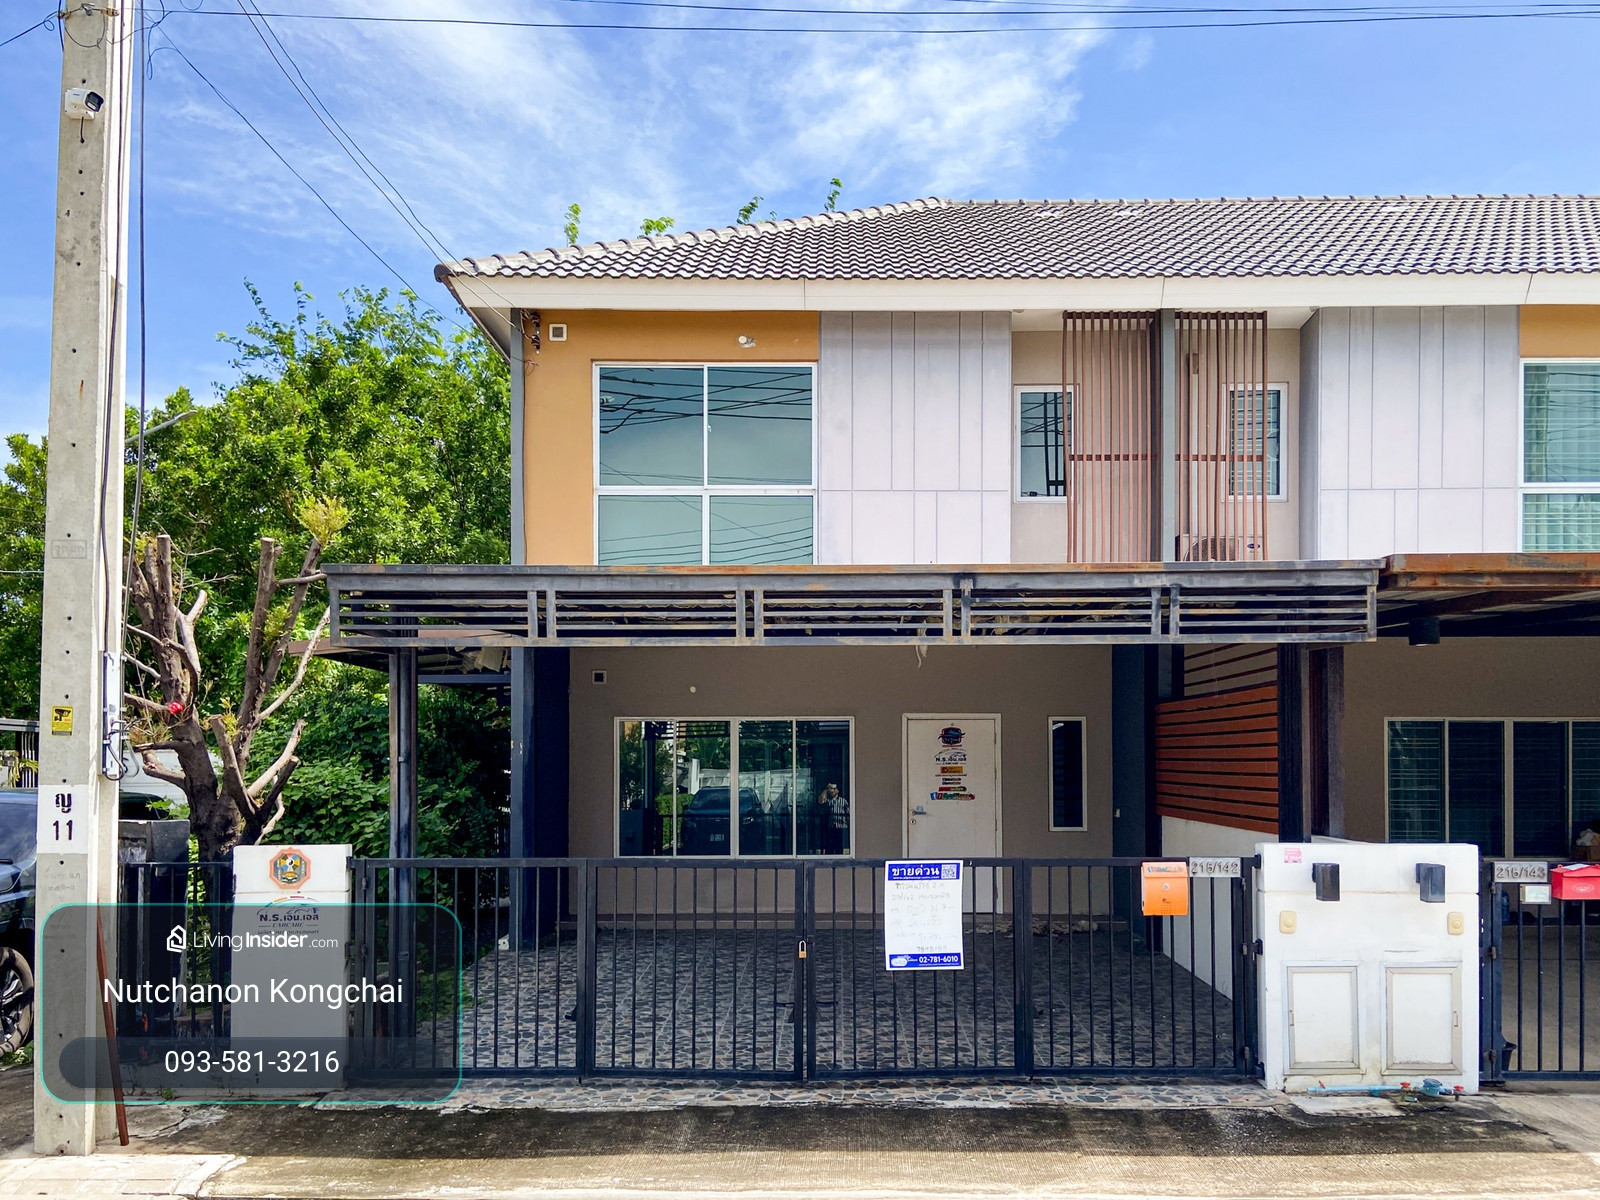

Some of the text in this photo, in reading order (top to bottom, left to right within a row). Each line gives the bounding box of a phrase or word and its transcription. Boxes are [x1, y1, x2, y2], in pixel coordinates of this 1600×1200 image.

[55, 793, 72, 814] ญ
[53, 820, 73, 841] 11
[892, 865, 940, 876] ขายด่วน
[1191, 861, 1240, 874] 215/142
[1495, 865, 1546, 879] 215/143
[918, 955, 958, 964] 02-781-6010
